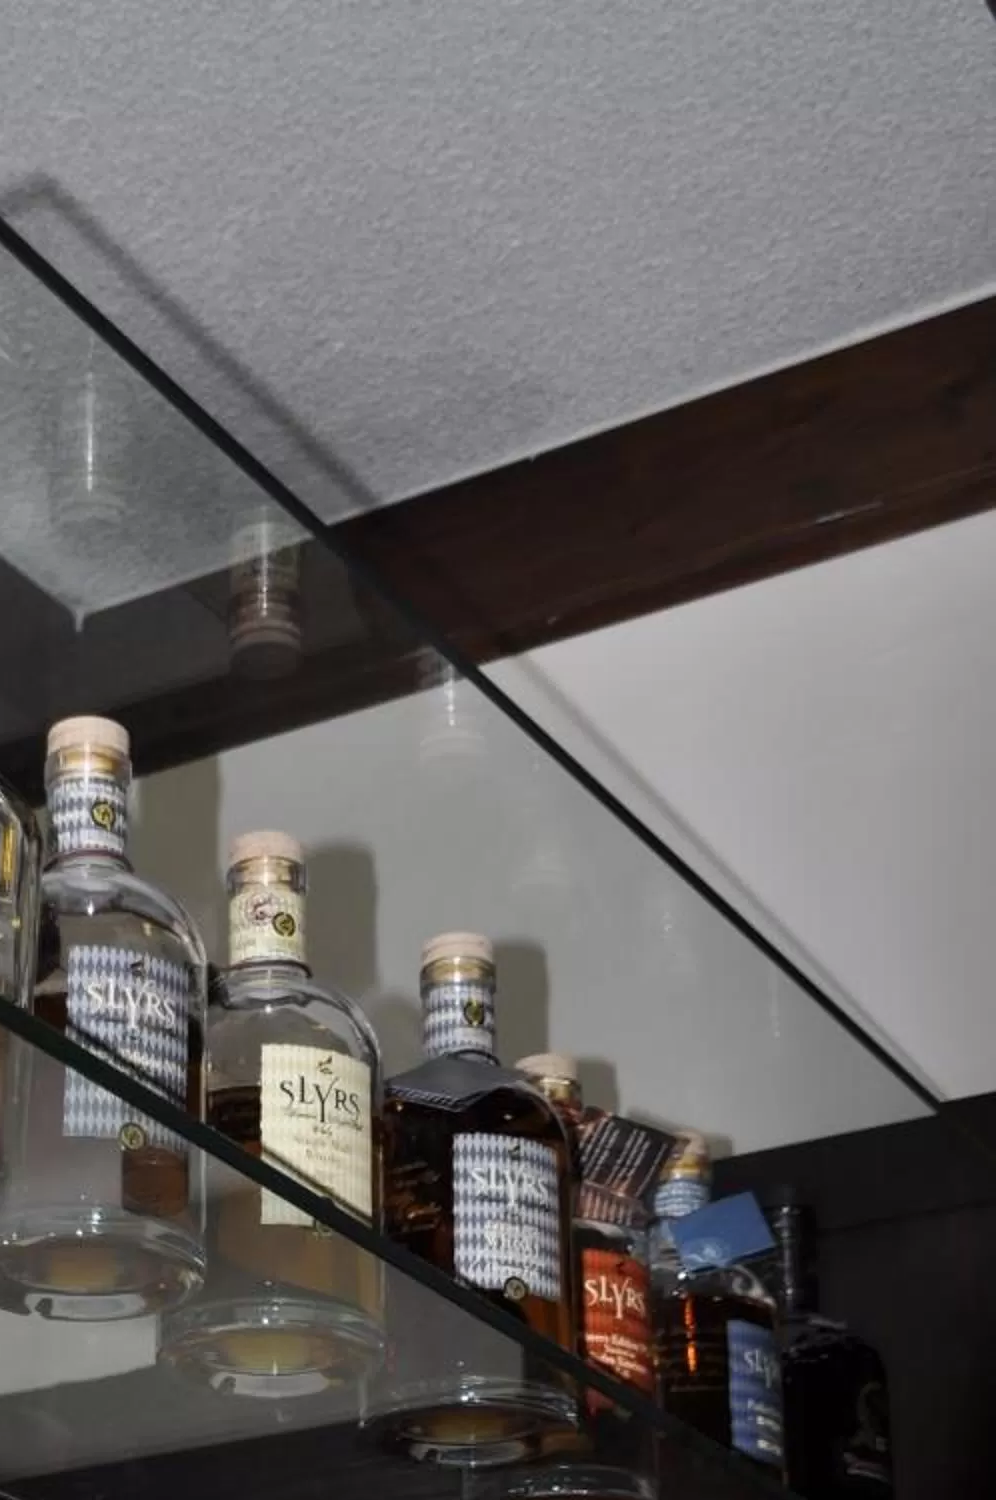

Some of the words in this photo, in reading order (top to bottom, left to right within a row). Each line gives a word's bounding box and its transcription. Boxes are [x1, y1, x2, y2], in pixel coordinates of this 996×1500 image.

[87, 976, 176, 1030] SLYRS
[279, 1075, 361, 1124] SLYRS
[470, 1161, 550, 1206] SLYRS
[583, 1274, 646, 1320] SLYRS
